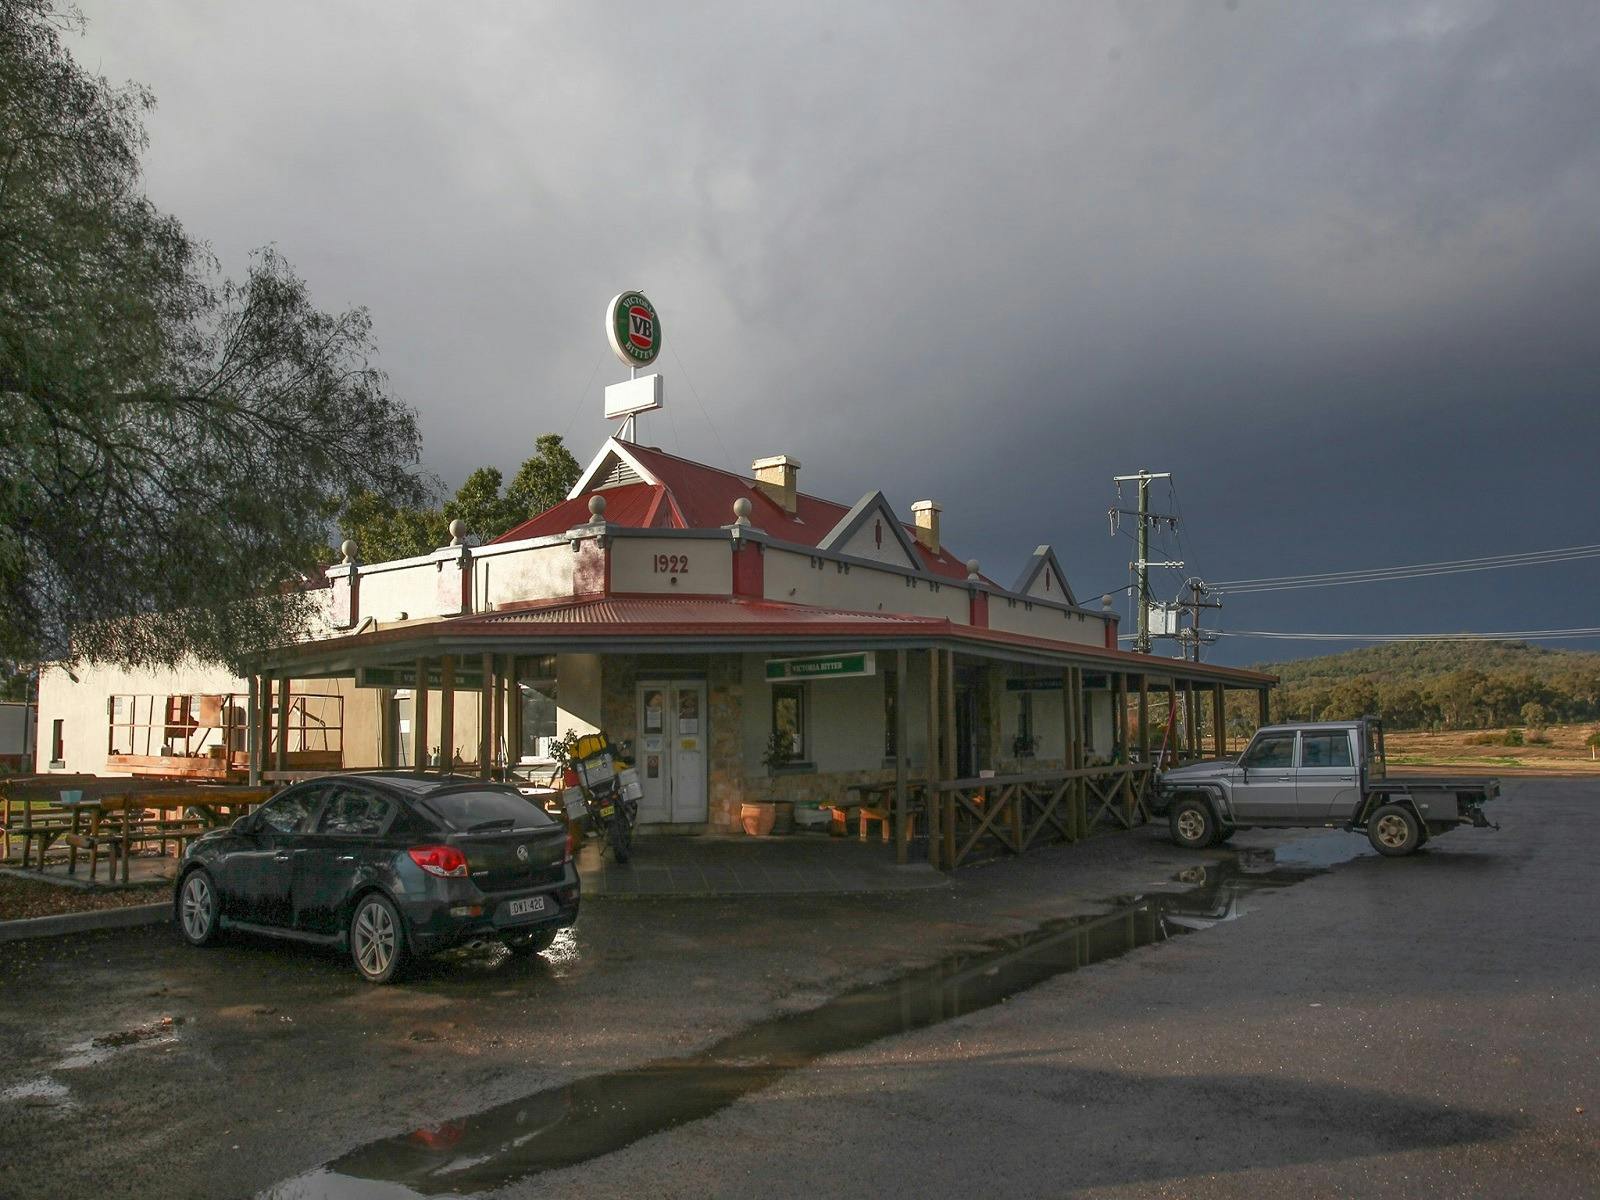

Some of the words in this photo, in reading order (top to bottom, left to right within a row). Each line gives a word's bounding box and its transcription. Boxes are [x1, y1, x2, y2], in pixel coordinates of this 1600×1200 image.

[630, 315, 653, 338] VB
[625, 341, 654, 359] BITTER
[654, 554, 689, 573] 1922
[820, 661, 843, 671] BITTER
